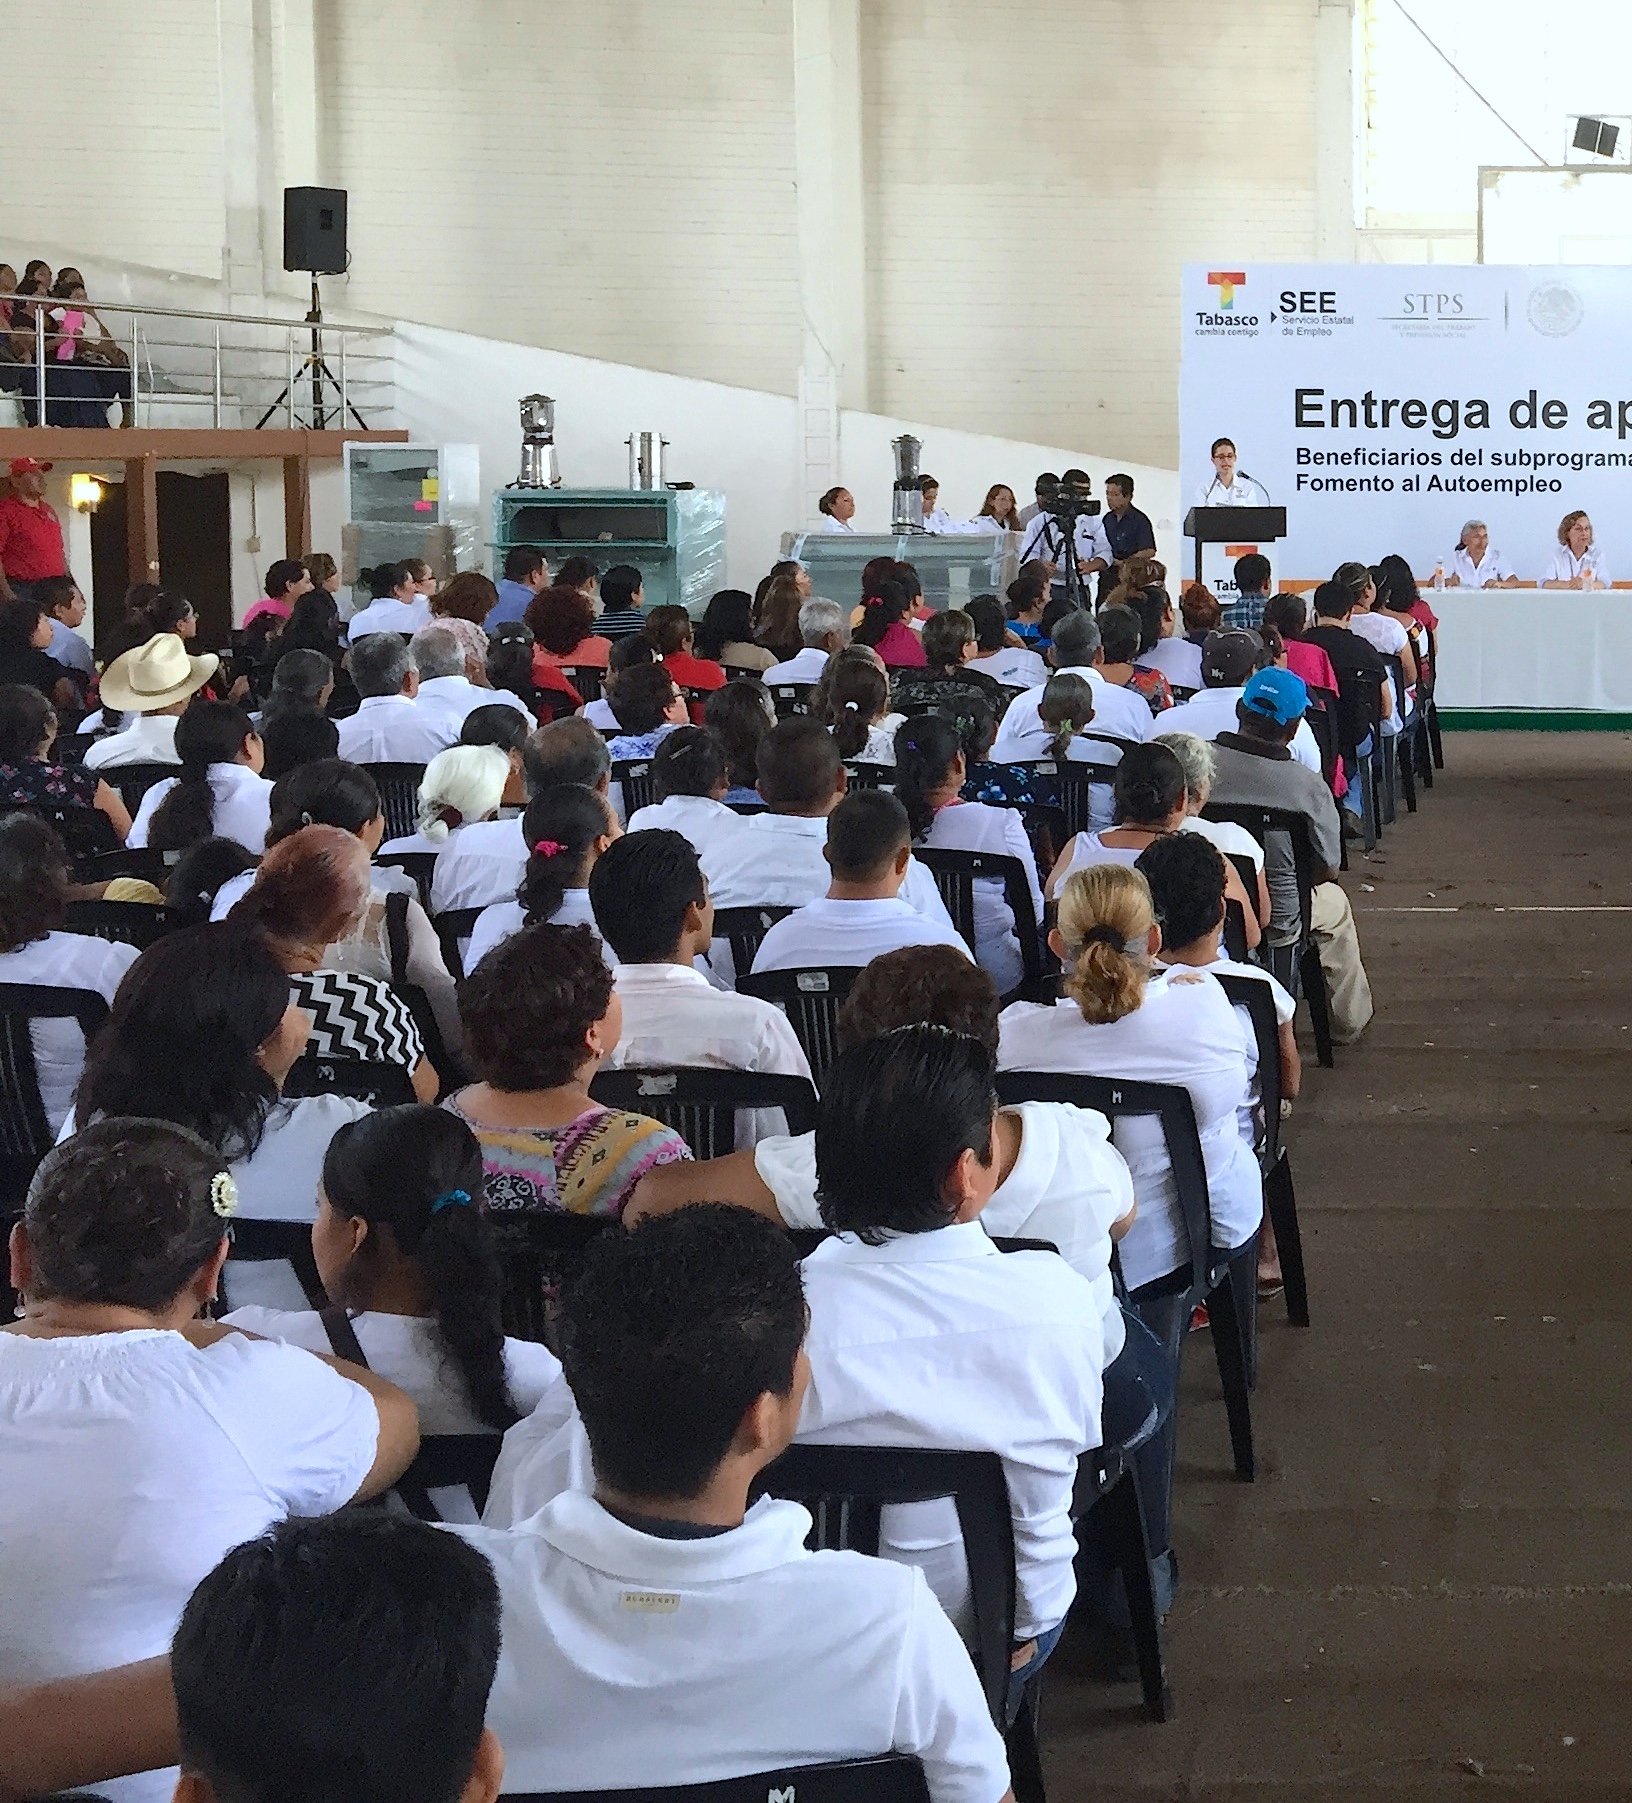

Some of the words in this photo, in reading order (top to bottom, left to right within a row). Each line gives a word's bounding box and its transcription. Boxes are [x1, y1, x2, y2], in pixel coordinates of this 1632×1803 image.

[1279, 291, 1337, 313] SEE
[1403, 294, 1464, 314] STPS
[1196, 312, 1259, 326] Tabasco
[1282, 315, 1320, 325] Servicio
[1322, 315, 1354, 325] Estatal
[1282, 327, 1294, 336] de
[1297, 327, 1333, 337] Empleo
[1295, 389, 1490, 439] Entrega
[1510, 390, 1567, 429] de
[1297, 448, 1442, 465] Beneficiarios
[1451, 449, 1482, 466] del
[1297, 474, 1394, 491] Fomento
[1402, 474, 1419, 491] al
[1427, 475, 1561, 496] Autoempleo
